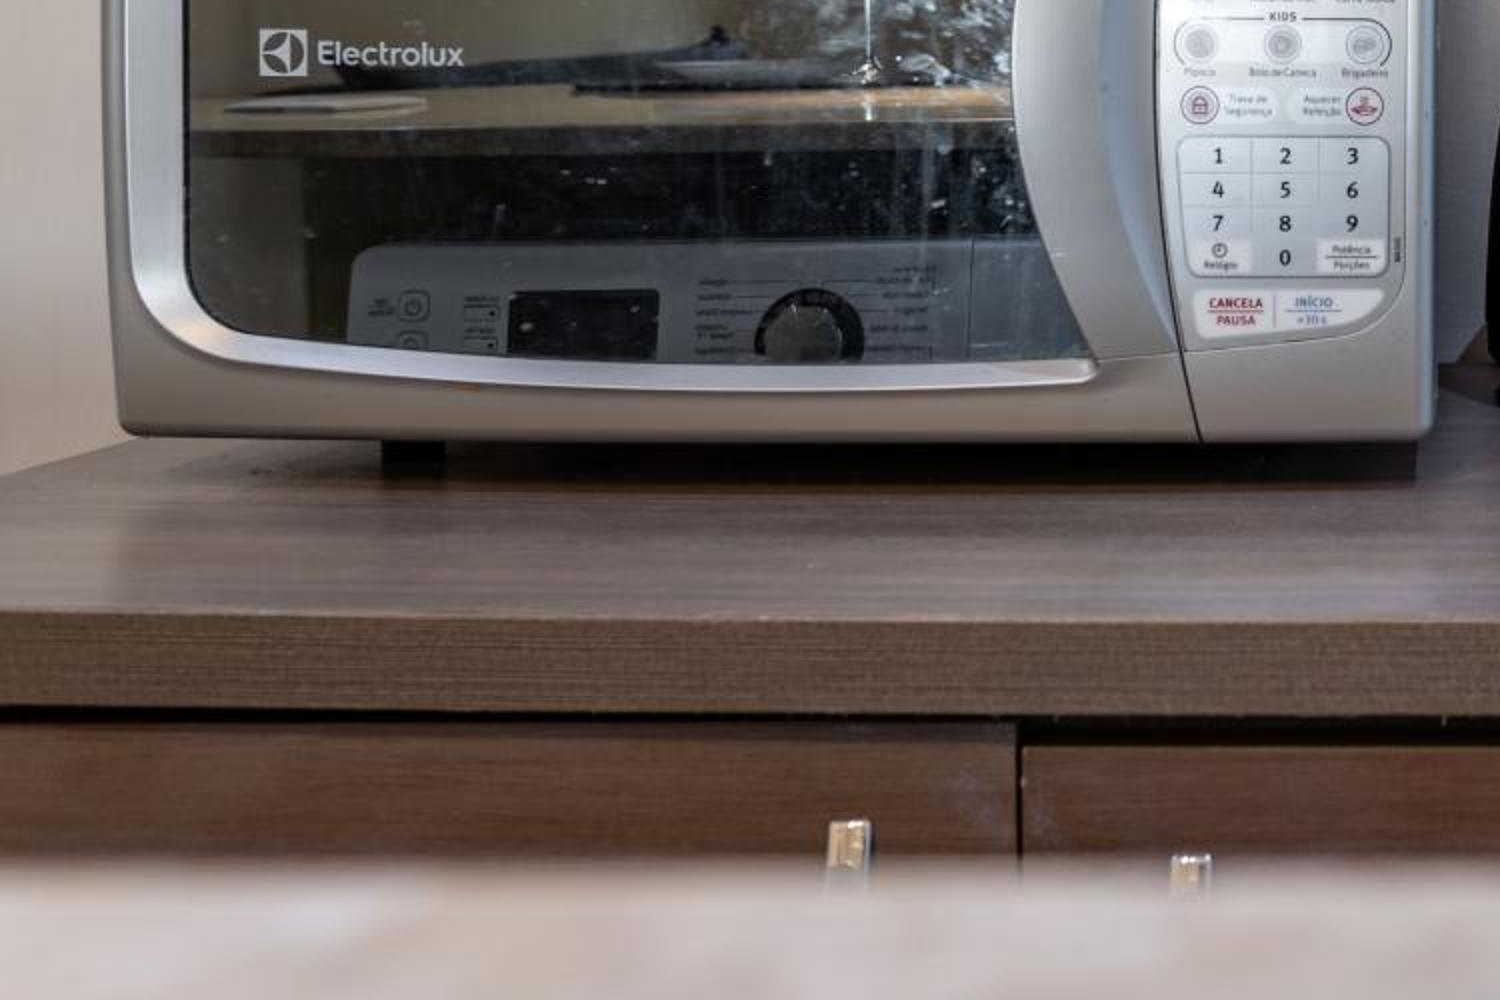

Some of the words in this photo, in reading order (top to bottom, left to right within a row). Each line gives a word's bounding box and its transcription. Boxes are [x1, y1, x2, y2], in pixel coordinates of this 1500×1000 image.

[1268, 11, 1298, 23] KIDS
[317, 40, 465, 67] Electrolux
[1214, 147, 1224, 165] 1
[1279, 147, 1292, 165] 2
[1346, 147, 1359, 165] 3
[1212, 181, 1225, 198] 4
[1279, 181, 1291, 199] 5
[1346, 181, 1359, 199] 6
[1212, 214, 1225, 232] 7
[1279, 215, 1292, 233] 8
[1346, 215, 1359, 233] 9
[1279, 249, 1292, 266] 0
[1208, 297, 1264, 309] CANCELA
[1294, 296, 1334, 308] INÍCIO
[1215, 314, 1257, 326] PAUSA
